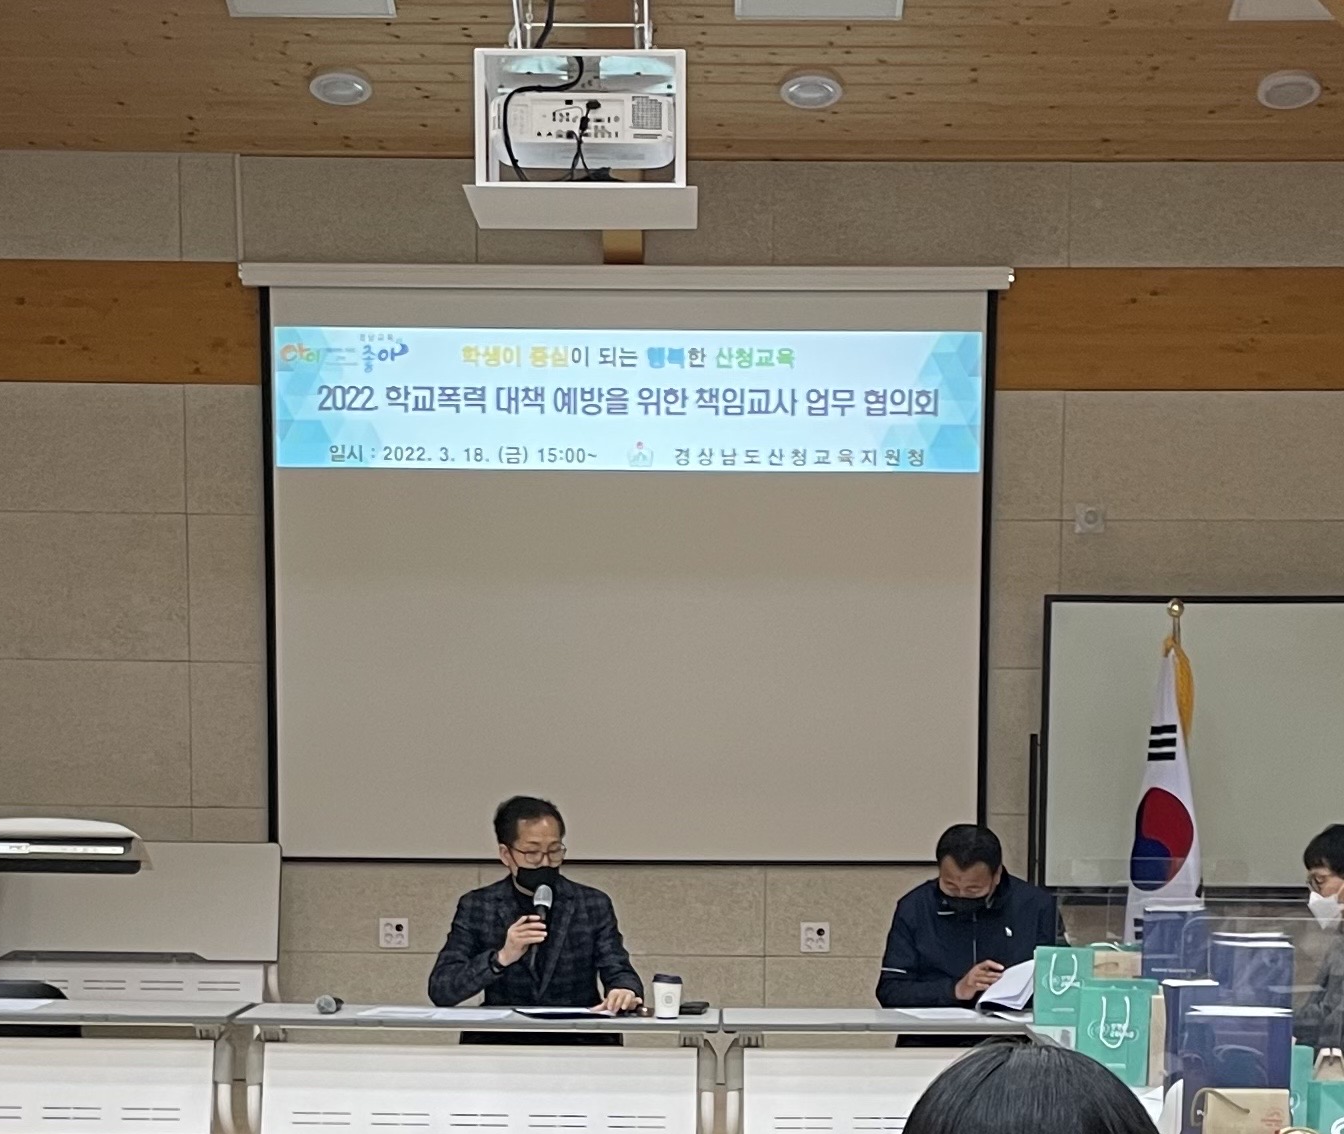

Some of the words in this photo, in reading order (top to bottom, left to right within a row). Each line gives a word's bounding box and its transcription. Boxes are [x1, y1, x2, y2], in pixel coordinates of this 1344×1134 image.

[462, 345, 522, 368] 학생이
[599, 346, 639, 368] 되는
[715, 347, 796, 369] 산청교육
[317, 384, 379, 412] 2022.
[385, 384, 487, 414] 학교폭력
[496, 385, 546, 415] 대책
[553, 386, 630, 416] 예방을
[637, 387, 688, 416] 위한
[695, 387, 798, 416] 책임교사
[806, 388, 856, 417] 업무
[863, 388, 940, 417] 협의회
[329, 444, 364, 463] 일시
[382, 445, 433, 462] 2022.
[439, 446, 456, 462] 3.
[464, 447, 490, 463] 18.
[498, 446, 529, 464] (금)
[537, 447, 598, 463] 15:00~
